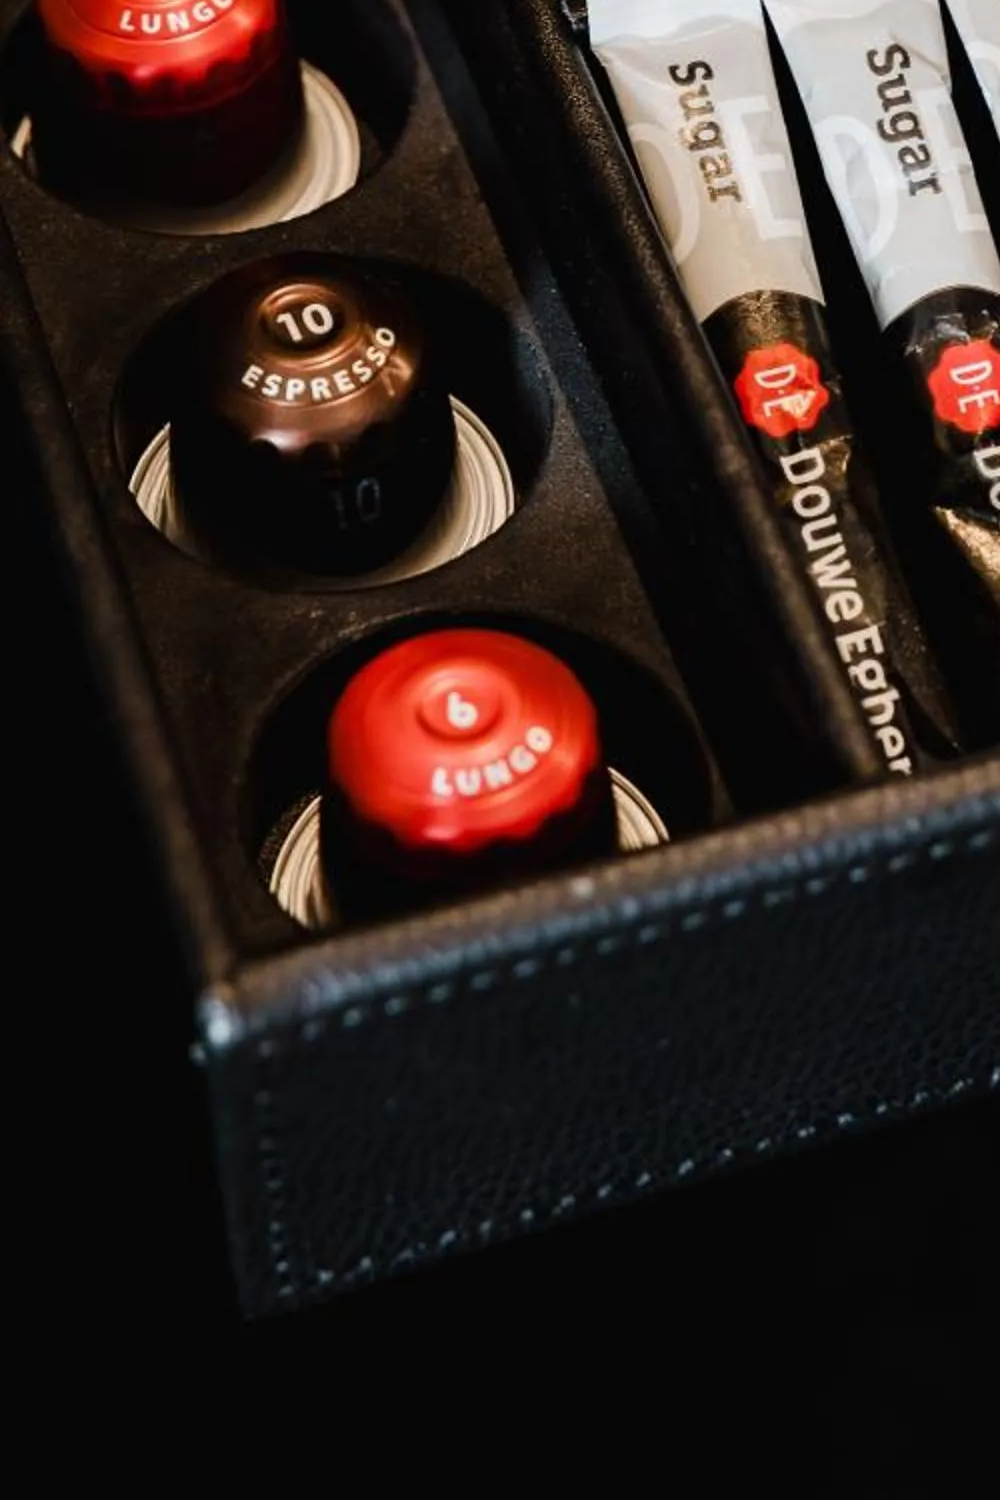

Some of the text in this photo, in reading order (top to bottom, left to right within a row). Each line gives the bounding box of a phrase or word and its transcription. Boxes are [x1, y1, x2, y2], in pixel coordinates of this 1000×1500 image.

[669, 59, 742, 204] Sugar
[867, 43, 943, 198] Sugar
[277, 303, 334, 343] 10
[241, 326, 396, 400] ESPRESSO
[328, 475, 382, 530] 10
[779, 449, 912, 775] Douwe Egber
[446, 692, 478, 728] 6
[431, 725, 554, 798] LUNGO
